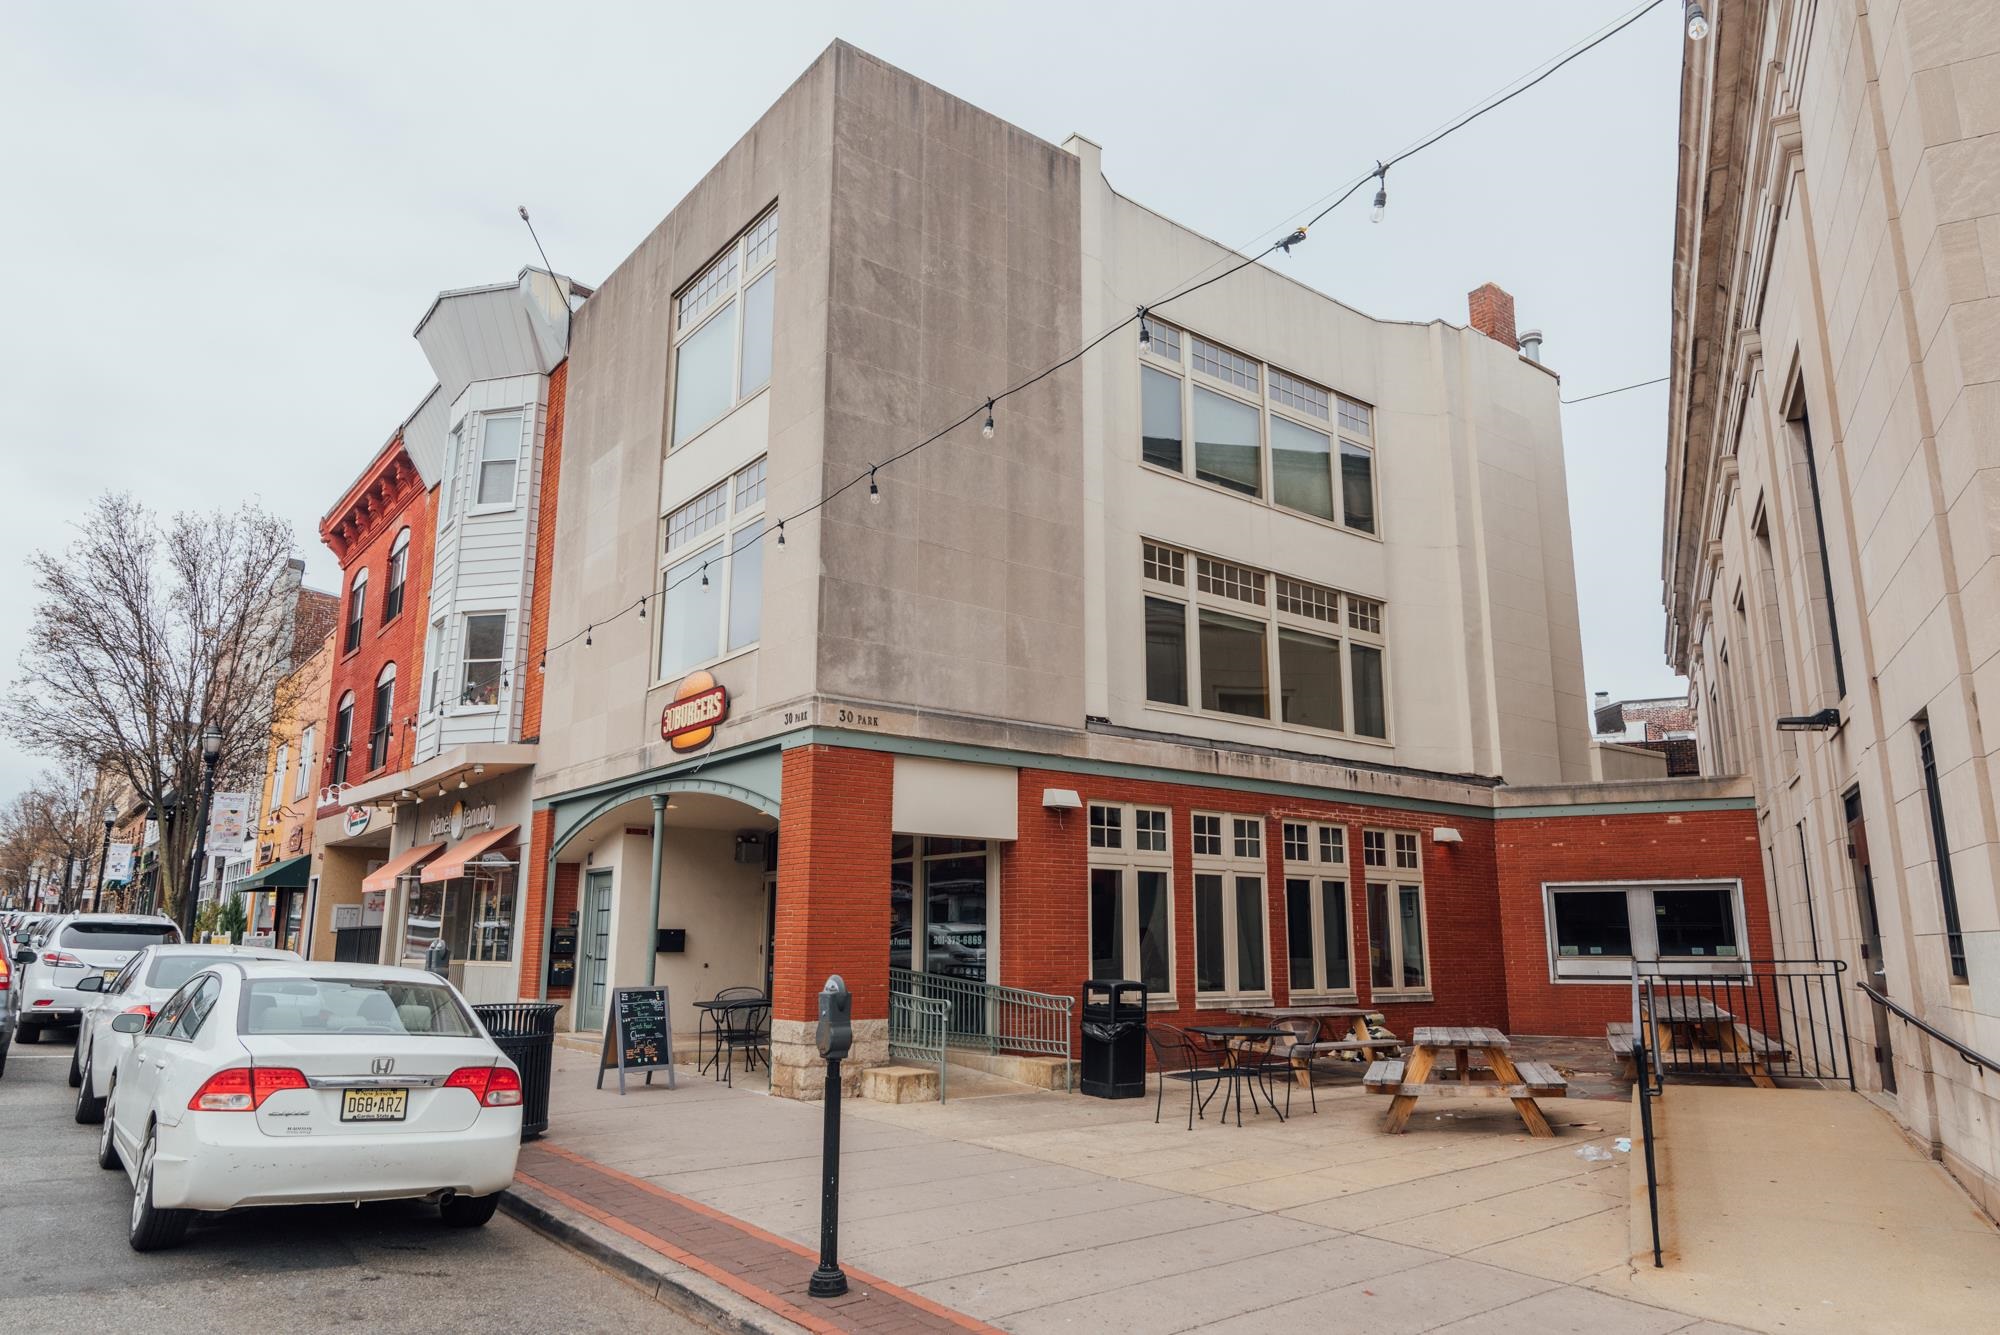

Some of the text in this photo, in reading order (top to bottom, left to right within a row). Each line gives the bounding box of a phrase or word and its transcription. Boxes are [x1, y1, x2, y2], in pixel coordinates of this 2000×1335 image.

[784, 711, 808, 725] 30 PARK
[839, 710, 879, 726] 30 PARK
[463, 801, 497, 829] tanning
[933, 935, 982, 945] 201-375-6869
